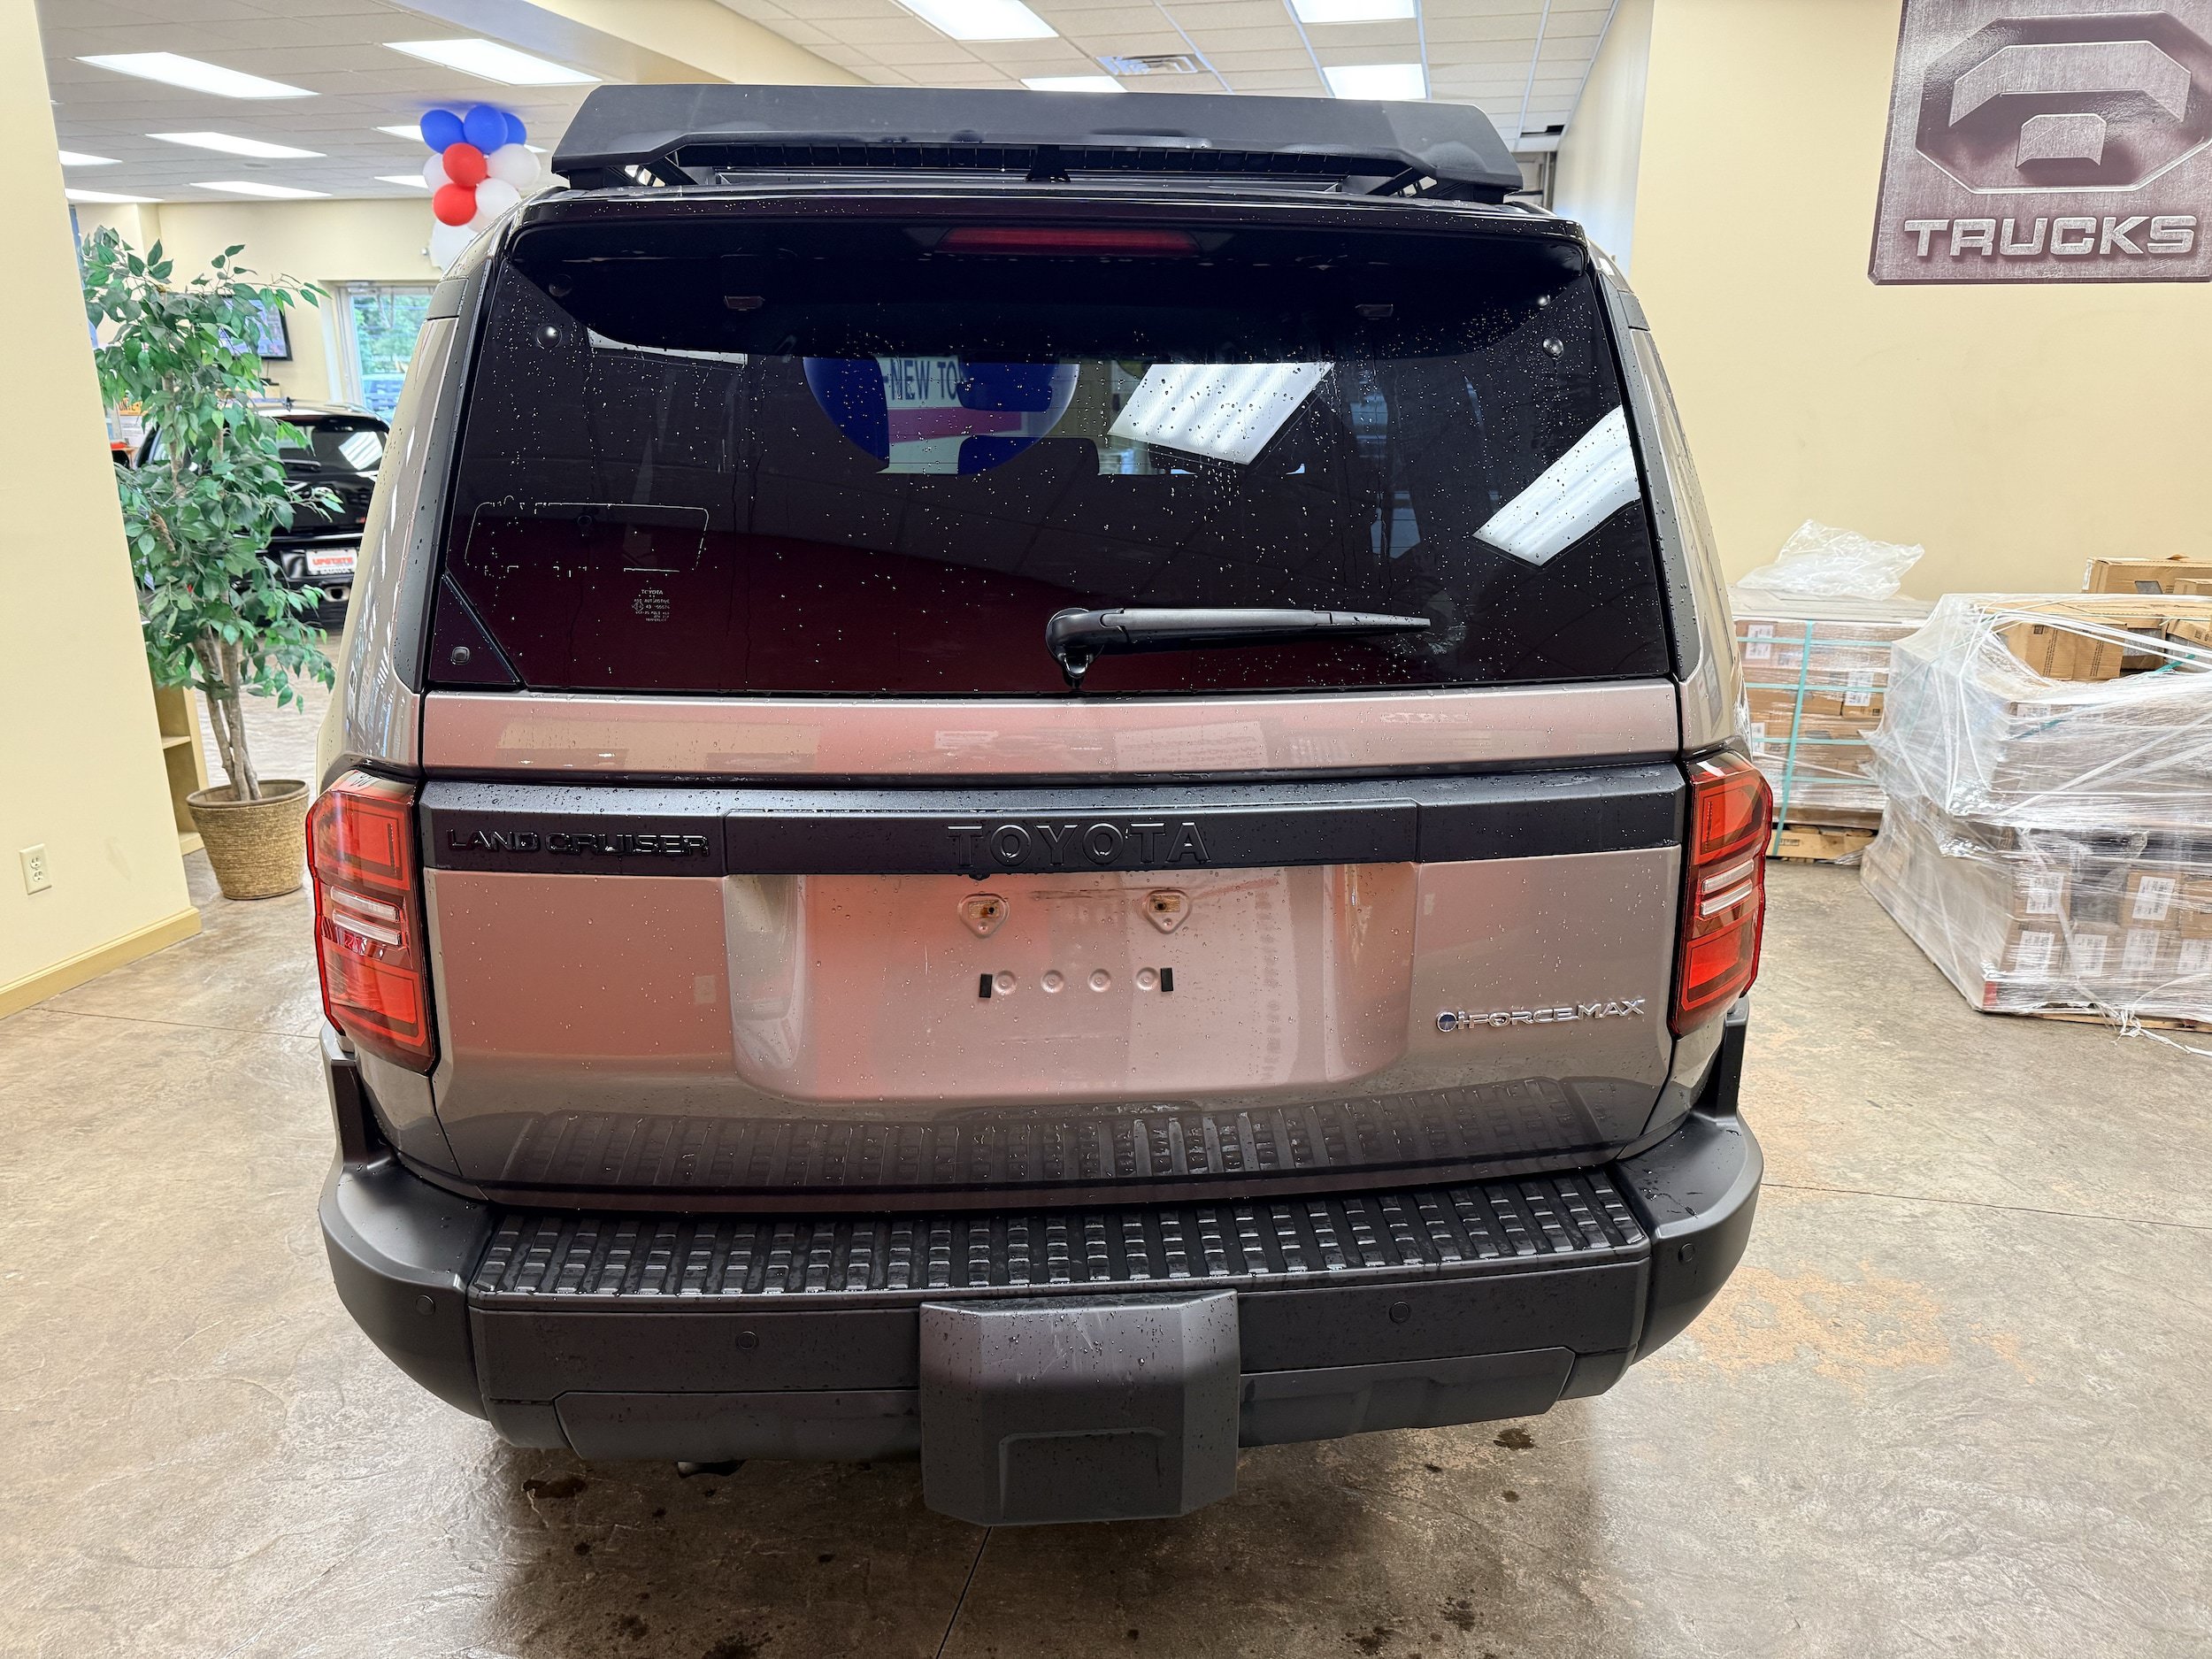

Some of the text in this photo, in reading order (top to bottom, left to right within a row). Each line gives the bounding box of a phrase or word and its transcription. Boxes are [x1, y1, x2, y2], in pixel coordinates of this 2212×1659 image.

[1903, 215, 2197, 257] TRUCKS
[937, 361, 958, 401] TO
[446, 828, 709, 856] LAND CRUISER
[946, 821, 1212, 868] TOYOTA
[1578, 998, 1646, 1019] MAX
